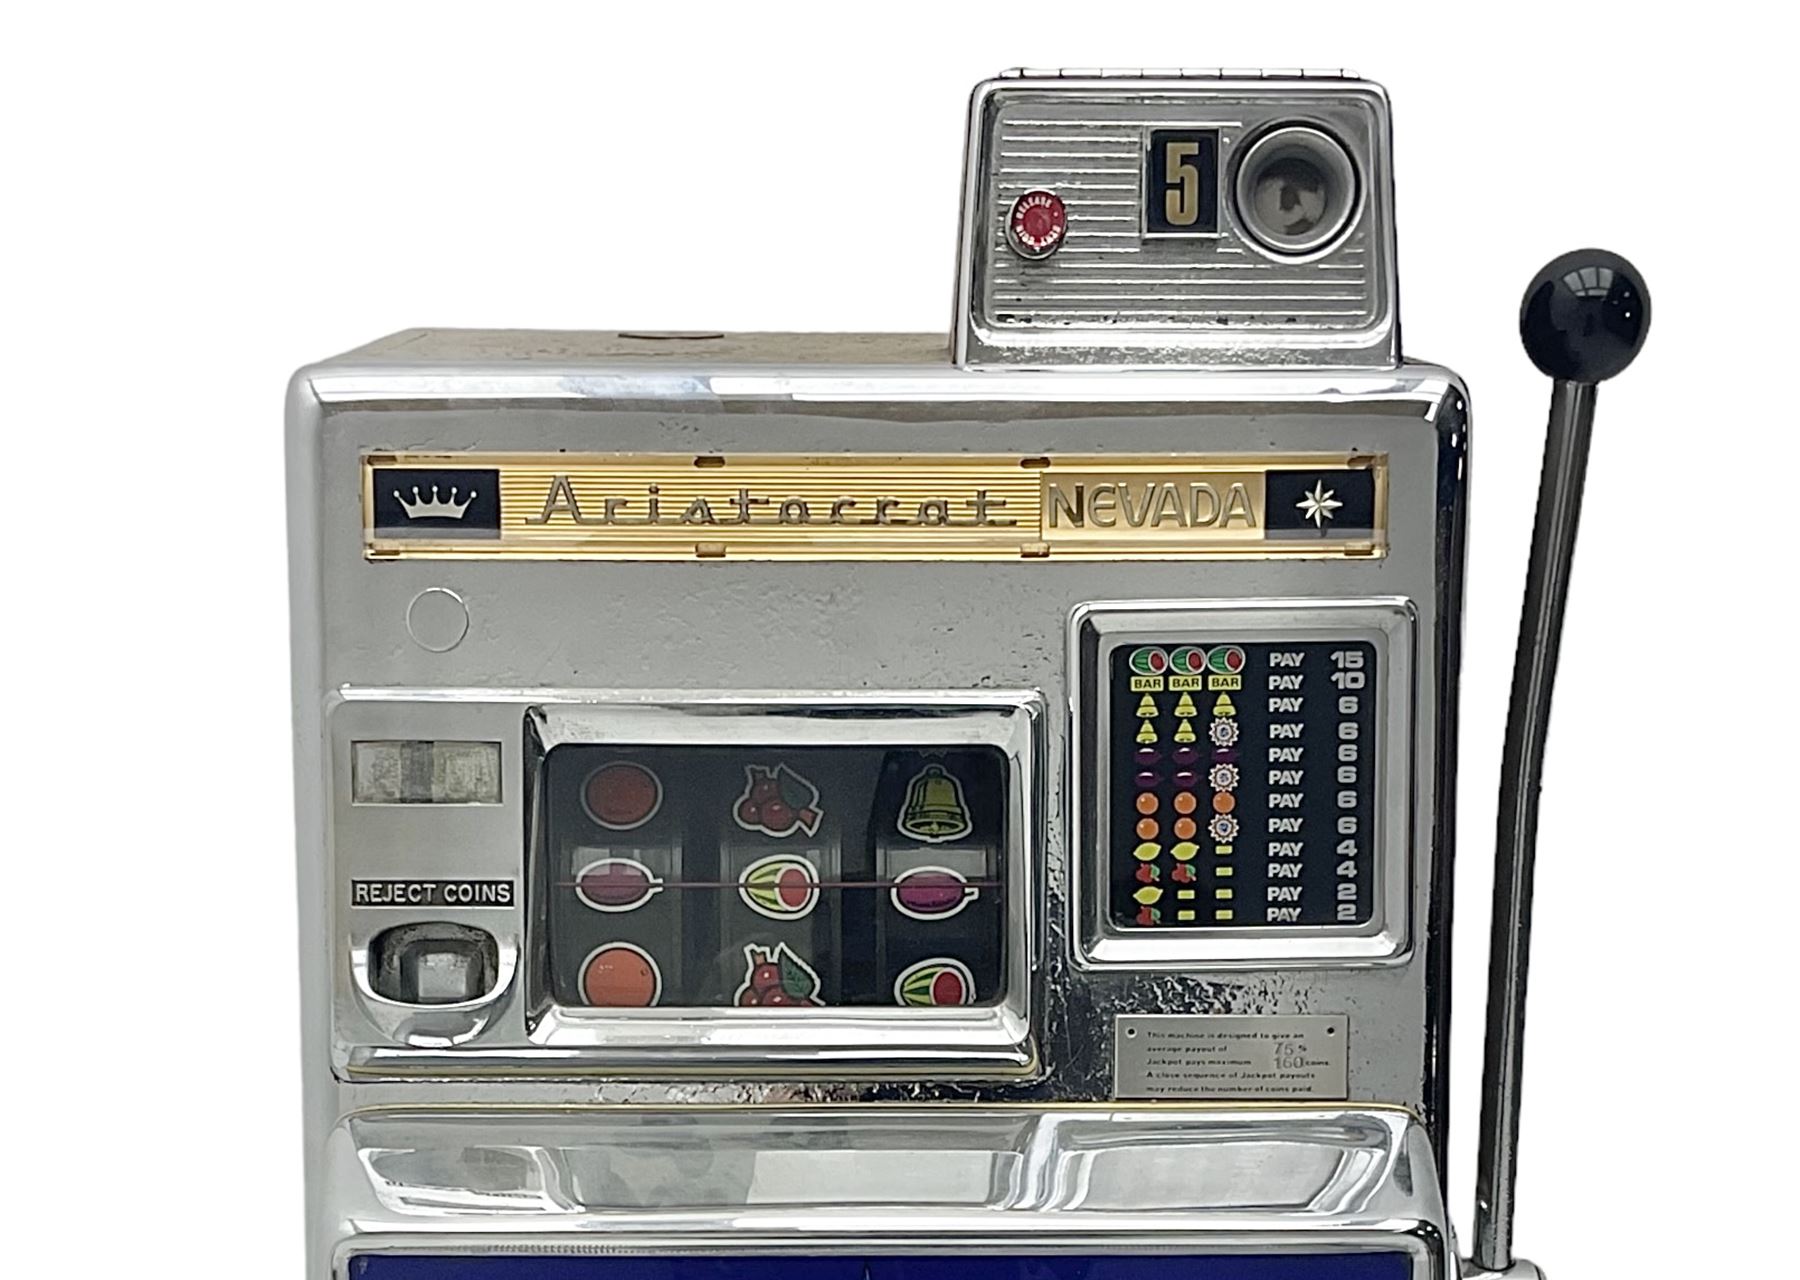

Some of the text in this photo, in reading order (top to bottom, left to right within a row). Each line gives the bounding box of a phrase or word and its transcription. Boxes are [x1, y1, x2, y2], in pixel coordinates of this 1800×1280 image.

[1164, 141, 1200, 226] 5
[525, 474, 1018, 526] Aristocrat
[1047, 481, 1257, 529] NEVADA
[1269, 650, 1365, 669] PAY 15
[1134, 671, 1365, 691] BAR BAR BAR PAY 10
[1268, 695, 1358, 714] PAY 6
[1268, 722, 1358, 741] PAY 6
[1268, 744, 1358, 763] PAY 6
[1268, 766, 1358, 786] PAY 6
[1268, 790, 1358, 809] PAY 6
[1268, 816, 1358, 835] PAY 6
[1268, 839, 1358, 858] PAY 4
[1268, 860, 1358, 878] PAY 4
[355, 883, 511, 903] REJECT COINS
[1266, 883, 1358, 902] PAY 2
[1266, 903, 1358, 922] PAY 2
